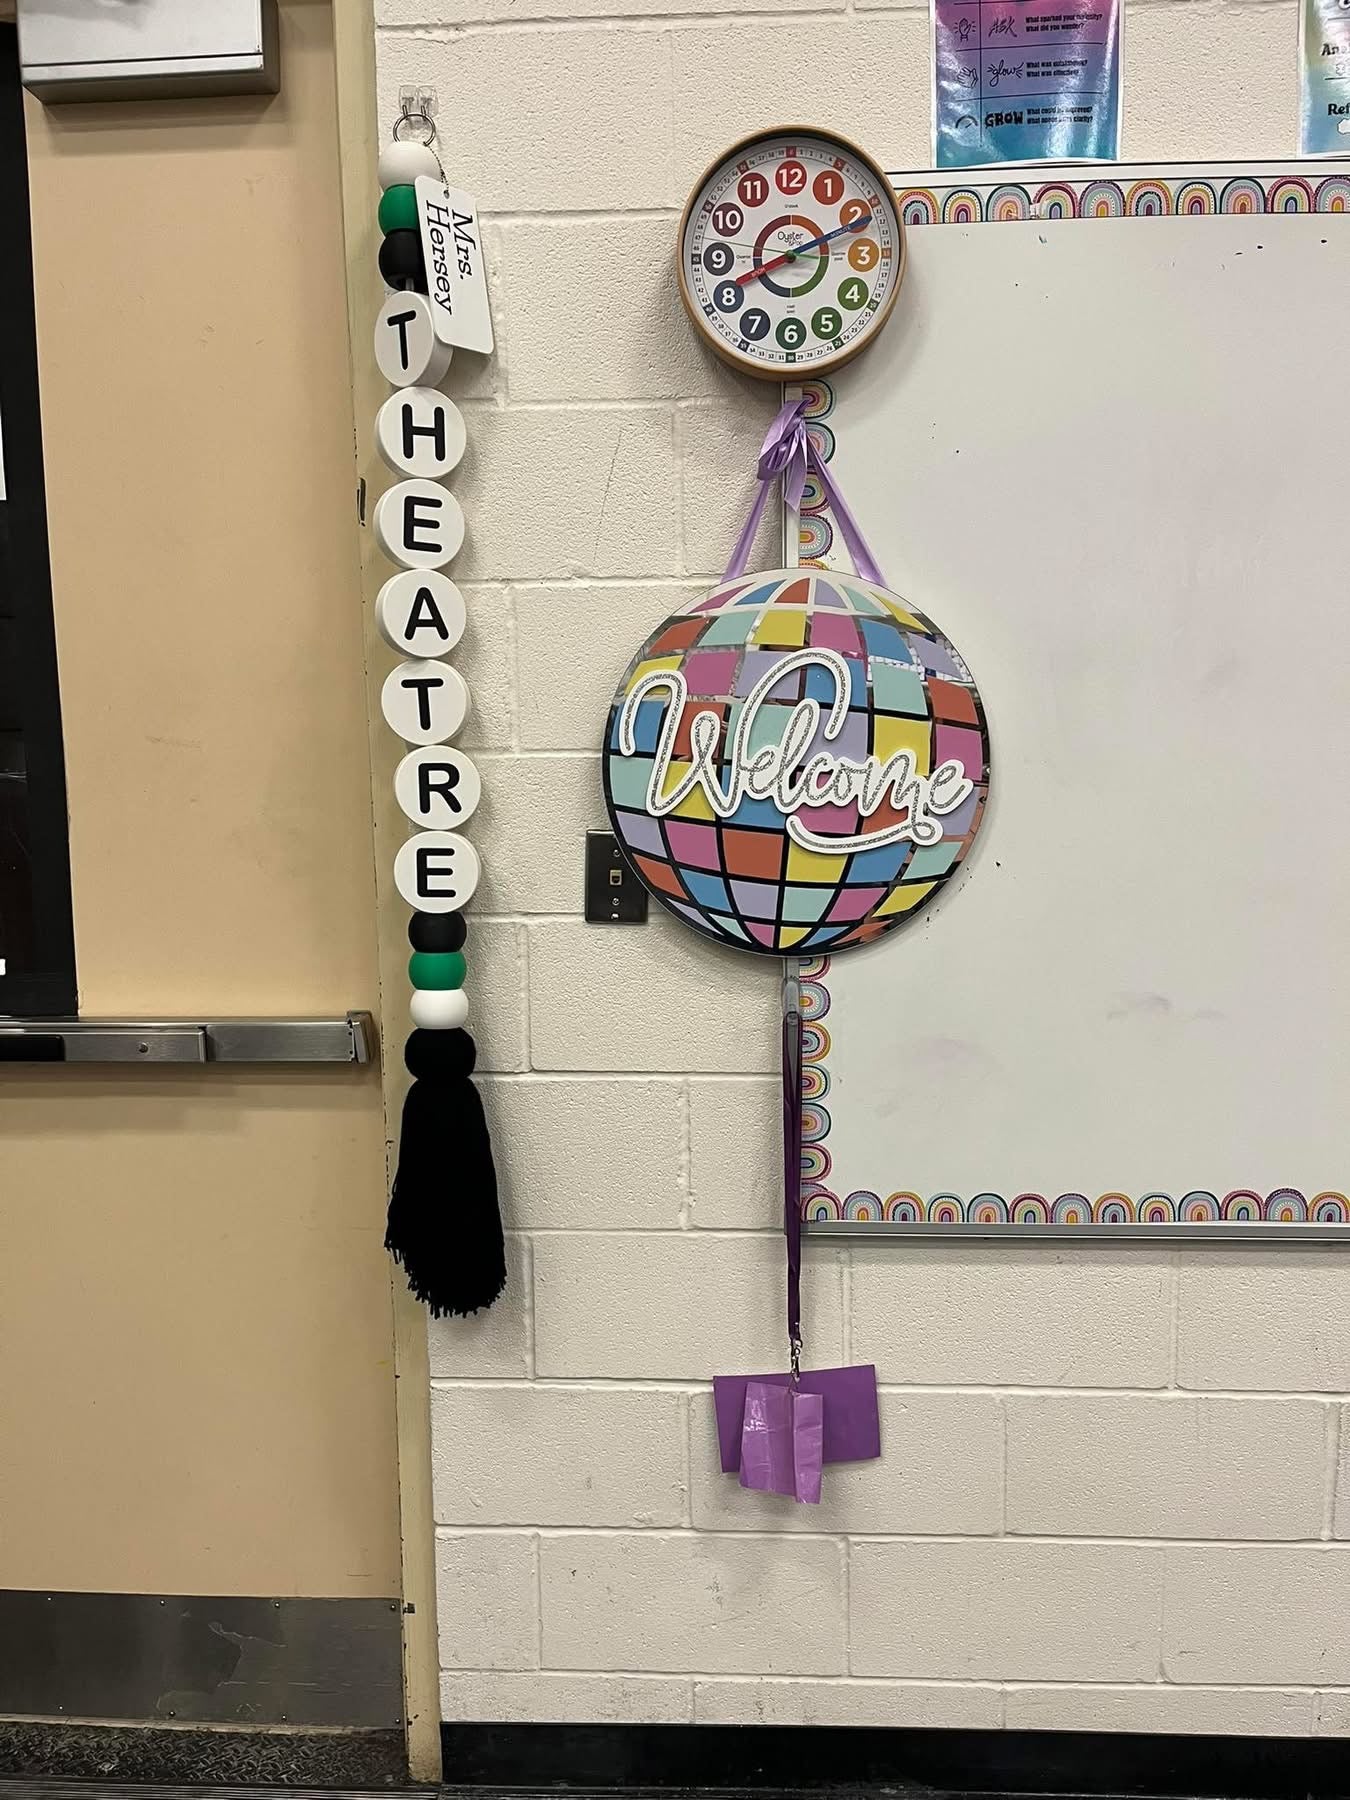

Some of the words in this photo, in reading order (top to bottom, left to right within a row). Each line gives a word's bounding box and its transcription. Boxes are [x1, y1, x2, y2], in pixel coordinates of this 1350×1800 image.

[988, 16, 1018, 37] ASK
[990, 60, 1017, 87] glow
[984, 111, 1023, 128] GROW
[779, 168, 803, 188] 12
[744, 181, 761, 199] 11
[824, 178, 832, 198] 1
[715, 210, 741, 229] 10
[849, 206, 862, 226] 2
[452, 208, 476, 280] Mrs.
[777, 231, 804, 243] Oyster
[426, 200, 452, 315] Hersey
[712, 250, 726, 268] 9
[857, 246, 871, 265] 3
[722, 288, 736, 306] 8
[845, 284, 860, 302] 4
[748, 316, 762, 334] 7
[820, 314, 833, 333] 5
[784, 325, 798, 343] 6
[618, 647, 974, 855] Welcome
